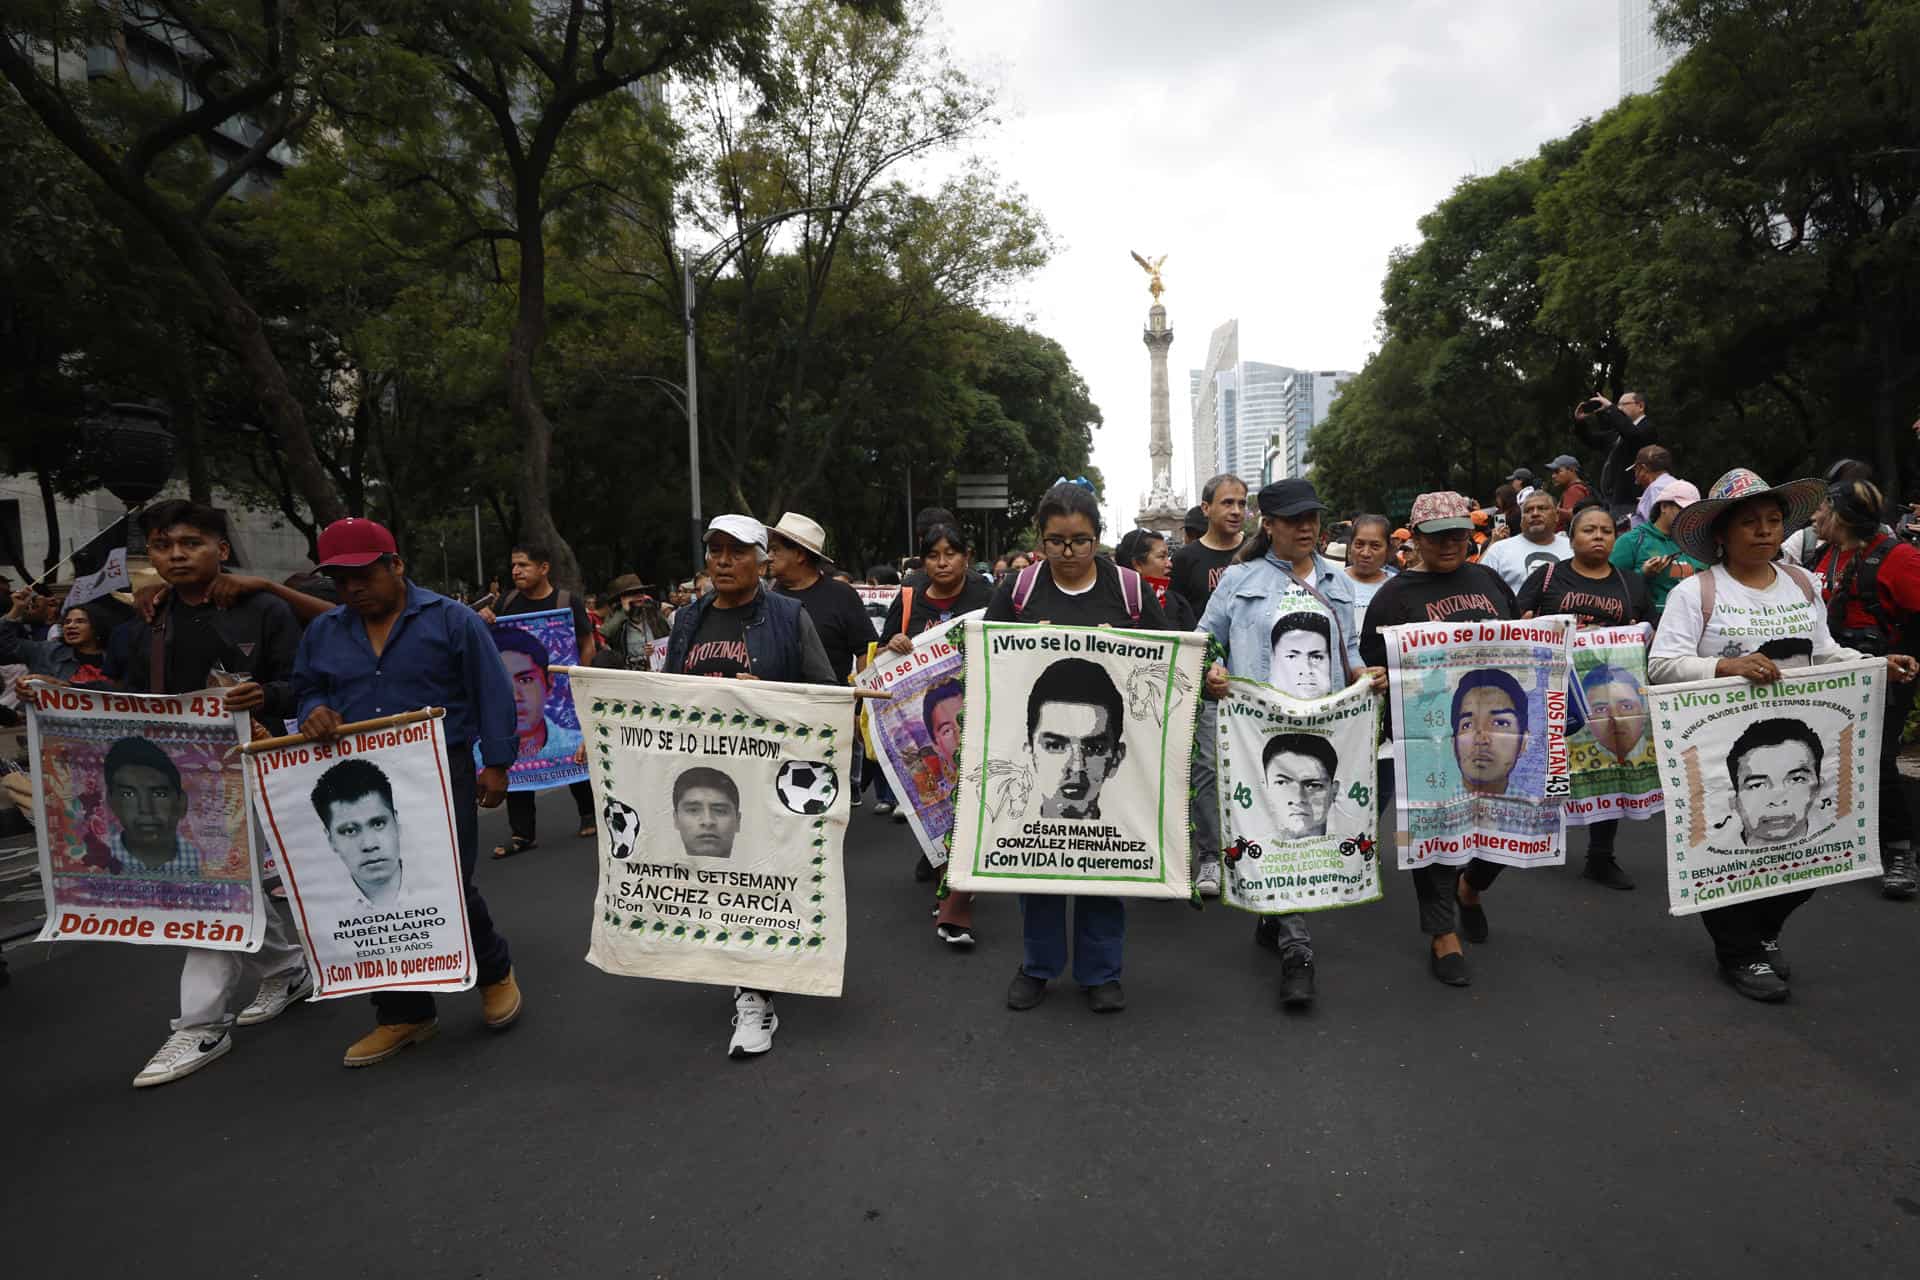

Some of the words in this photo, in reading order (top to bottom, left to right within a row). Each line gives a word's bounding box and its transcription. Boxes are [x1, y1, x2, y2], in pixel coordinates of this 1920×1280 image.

[878, 589, 896, 599] llev
[1560, 591, 1623, 623] AYOTZINAPA
[1424, 593, 1499, 622] AYOTZINAPA
[1402, 629, 1448, 653] ¡Vivo
[1454, 628, 1473, 643] se
[1479, 624, 1495, 641] lo
[1500, 624, 1564, 645] llevaron!
[1590, 632, 1604, 645] lo
[1609, 630, 1644, 644] lleva
[1719, 627, 1785, 637] ASCENCIO
[1788, 621, 1817, 635] BAUT
[993, 635, 1036, 653] ¡Vivo
[1041, 636, 1060, 650] se
[1064, 634, 1081, 651] lo
[1086, 635, 1164, 660] llevaron!
[896, 661, 912, 676] se
[915, 650, 929, 667] lo
[1674, 692, 1721, 711] ¡Vivo
[1726, 690, 1746, 704] se
[1750, 684, 1769, 700] lo
[1773, 672, 1856, 698] llevaron!
[190, 696, 229, 718] 43
[1228, 702, 1264, 719] ¡Vivo
[1267, 713, 1284, 724] se
[1287, 716, 1302, 726] lo
[1307, 699, 1372, 727] llevaron!
[1548, 691, 1565, 720] NOS
[1424, 711, 1446, 728] 43
[1681, 719, 1706, 741] NUNCA
[1707, 707, 1740, 722] OLVIDES
[1742, 702, 1758, 712] QUE
[1772, 699, 1810, 707] ESTAMOS
[1812, 700, 1855, 720] ESPERANDO
[262, 749, 309, 775] ¡Vivo
[313, 743, 333, 761] se
[337, 739, 351, 756] lo
[356, 722, 429, 753] llevaron!
[621, 727, 652, 747] ¡VIVO
[658, 732, 673, 750] SE
[679, 734, 697, 754] LO
[703, 735, 780, 759] LLEVARON!
[1549, 725, 1568, 775] FALTAN
[1425, 772, 1448, 789] 43
[1546, 775, 1570, 797] 43!
[1233, 781, 1252, 809] 43
[1564, 800, 1593, 817] ¡Vivo
[1597, 798, 1610, 809] lo
[1023, 820, 1066, 836] CÉSAR
[1068, 825, 1122, 838] MANUEL
[996, 836, 1066, 850] GONZÁLEZ
[1068, 837, 1146, 852] HERNÁNDEZ
[1263, 851, 1297, 863] JORGE
[1300, 849, 1340, 859] ANTONIO
[1417, 837, 1459, 859] ¡Vivo
[1463, 835, 1472, 850] lo
[1472, 832, 1551, 855] queremos!
[985, 851, 1018, 869] ¡Con
[1021, 852, 1057, 866] VIDA
[1060, 854, 1075, 868] lo
[1077, 856, 1154, 872] queremos!
[1259, 863, 1295, 875] TIZAPA
[1692, 859, 1747, 880] BENJAMÍN
[1750, 851, 1803, 868] ASCENCIO
[1805, 840, 1854, 857] BAUTISTA
[626, 863, 689, 881] MARTÍN
[697, 870, 798, 891] GETSEMANY
[1265, 876, 1294, 888] VIDA
[1296, 874, 1308, 887] lo
[1309, 870, 1363, 887] queremos!
[1694, 886, 1725, 905] ¡Con
[1728, 877, 1762, 894] VIDA
[1765, 874, 1778, 887] lo
[1782, 860, 1854, 884] queremos!
[620, 879, 708, 905] SÁNCHEZ
[717, 892, 792, 913] GARCÍA
[338, 907, 439, 928] MAGDALENO
[612, 898, 643, 913] ¡Con
[653, 903, 691, 917] VIDA
[698, 908, 712, 920] lo
[720, 911, 800, 930] queremos!
[59, 913, 155, 938] Dónde
[163, 919, 244, 942] están
[334, 925, 388, 942] RUBÉN
[392, 916, 446, 933] LAURO
[354, 930, 430, 949] VILLEGAS
[390, 945, 402, 955] 19
[404, 941, 433, 953] AÑOS
[326, 963, 352, 987] ¡Con
[355, 959, 384, 979] VIDA
[387, 957, 397, 976] lo
[400, 950, 463, 978] queremos!
